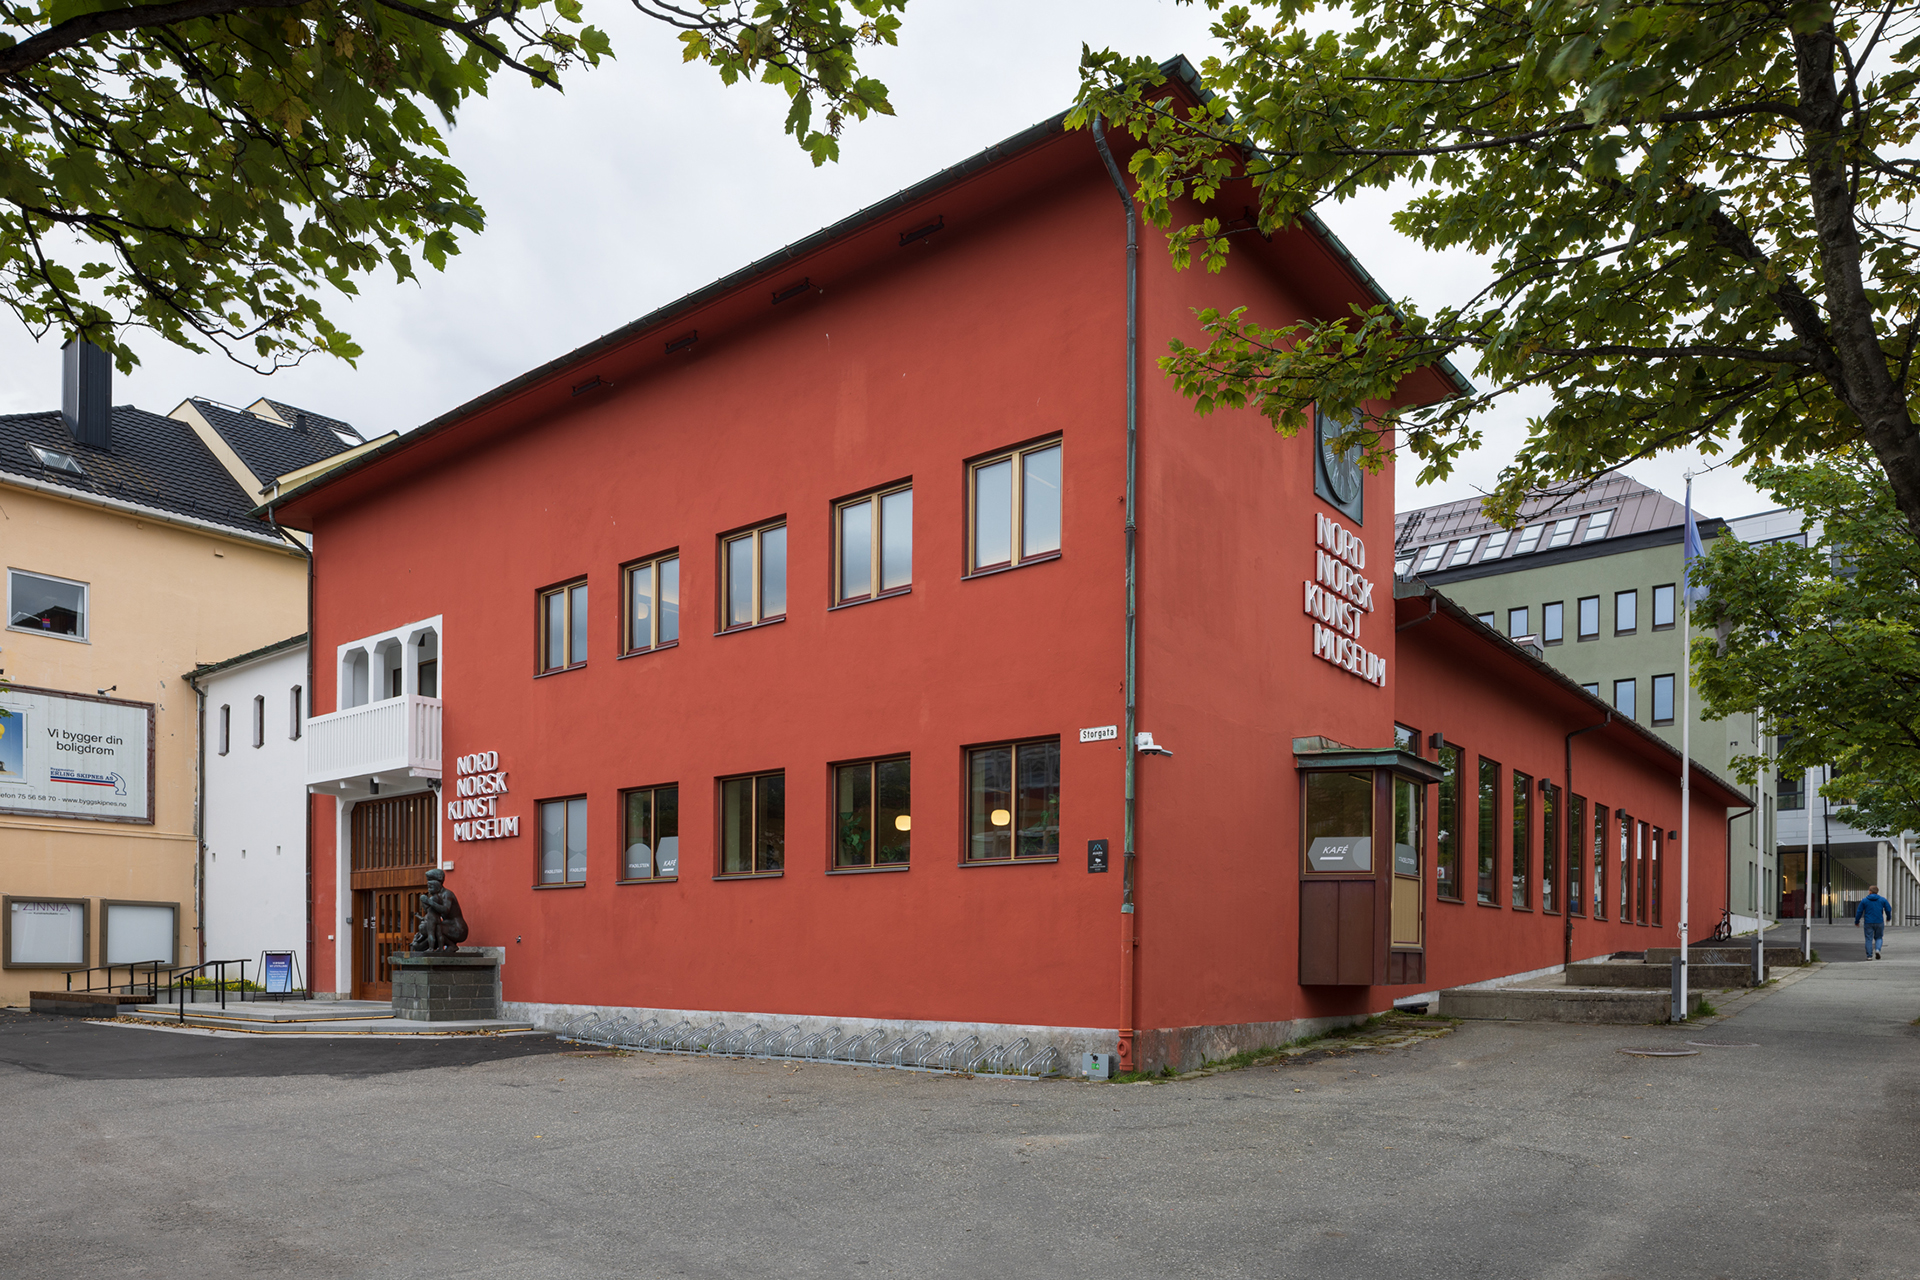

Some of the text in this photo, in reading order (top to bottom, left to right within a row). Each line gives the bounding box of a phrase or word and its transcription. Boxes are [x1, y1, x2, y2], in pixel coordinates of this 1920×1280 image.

[1316, 512, 1365, 569] NORD
[1316, 549, 1374, 612] NORSK
[1304, 580, 1363, 639] KUNST
[1313, 623, 1386, 687] MUSEUM
[47, 727, 123, 745] Vi bygger din
[1082, 728, 1114, 739] Storgata
[56, 740, 114, 756] boligdrøm
[50, 770, 75, 778] ERLING
[457, 751, 499, 776] NORD
[457, 771, 508, 797] NORSK
[448, 796, 498, 820] KUNST
[454, 816, 520, 841] MUSEUM
[1322, 844, 1349, 854] KAFÉ
[663, 859, 677, 867] KAFÉ
[22, 902, 71, 912] ZINNIA
